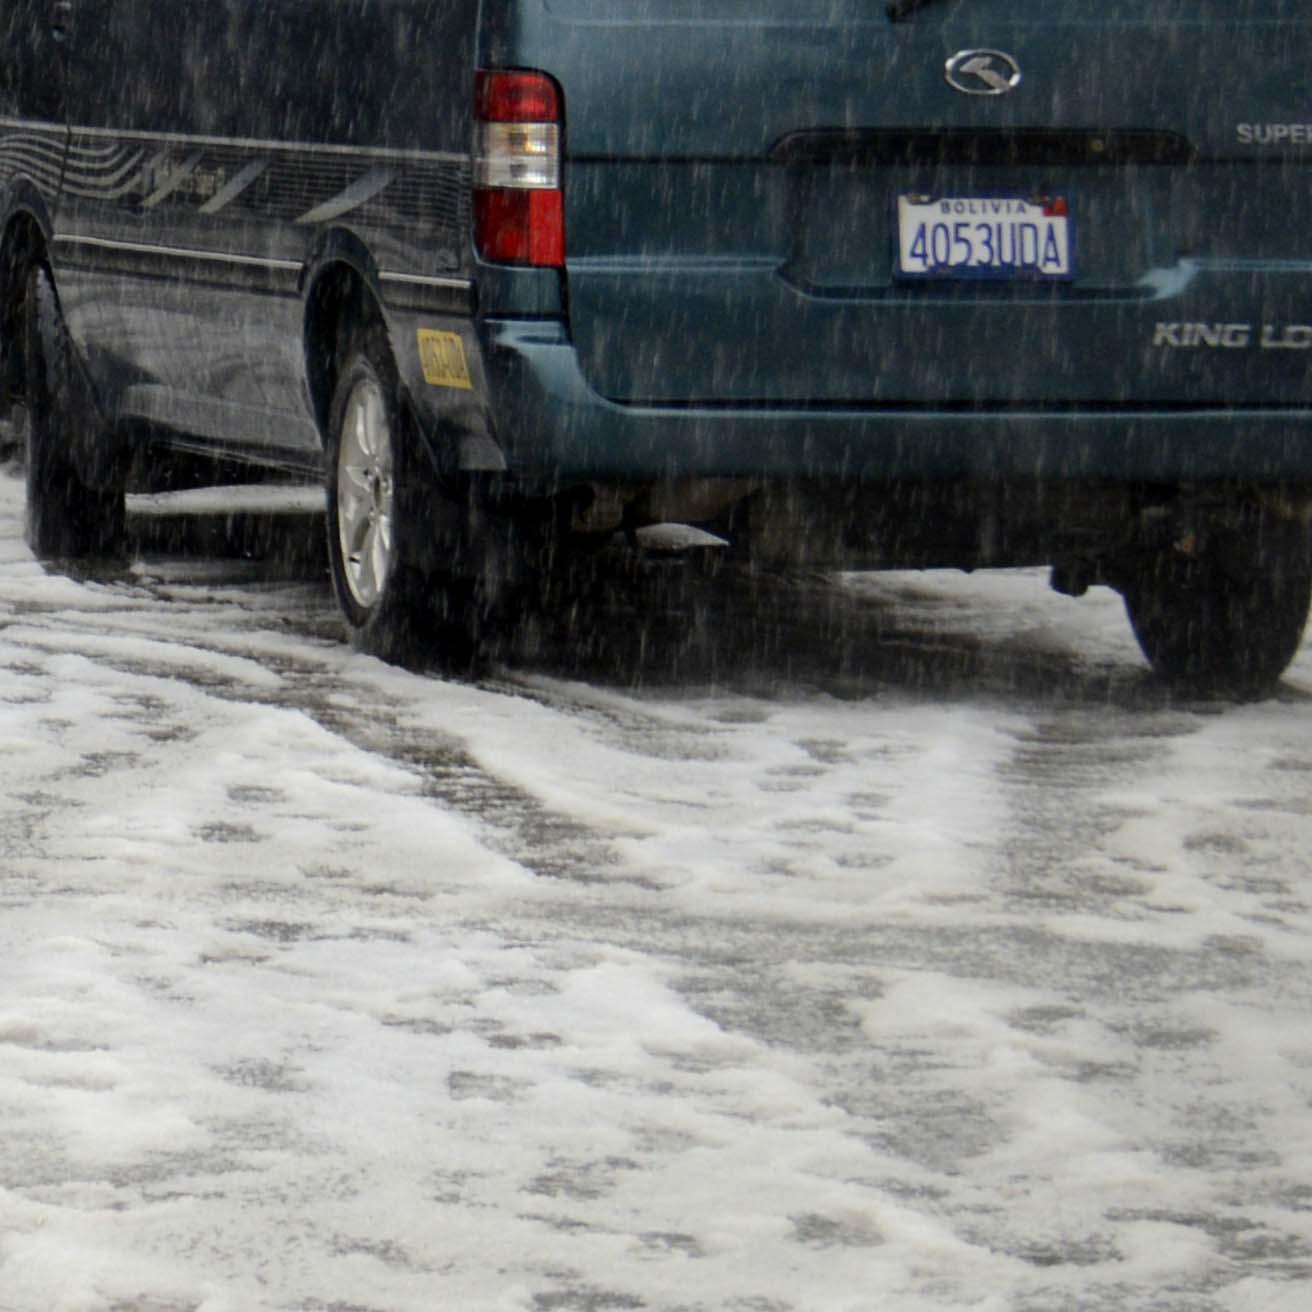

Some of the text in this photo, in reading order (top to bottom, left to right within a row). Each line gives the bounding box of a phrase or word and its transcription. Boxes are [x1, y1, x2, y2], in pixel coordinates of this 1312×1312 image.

[940, 199, 1028, 216] BOLIVIA
[909, 221, 1062, 270] 4053UDA
[1152, 321, 1251, 348] KING
